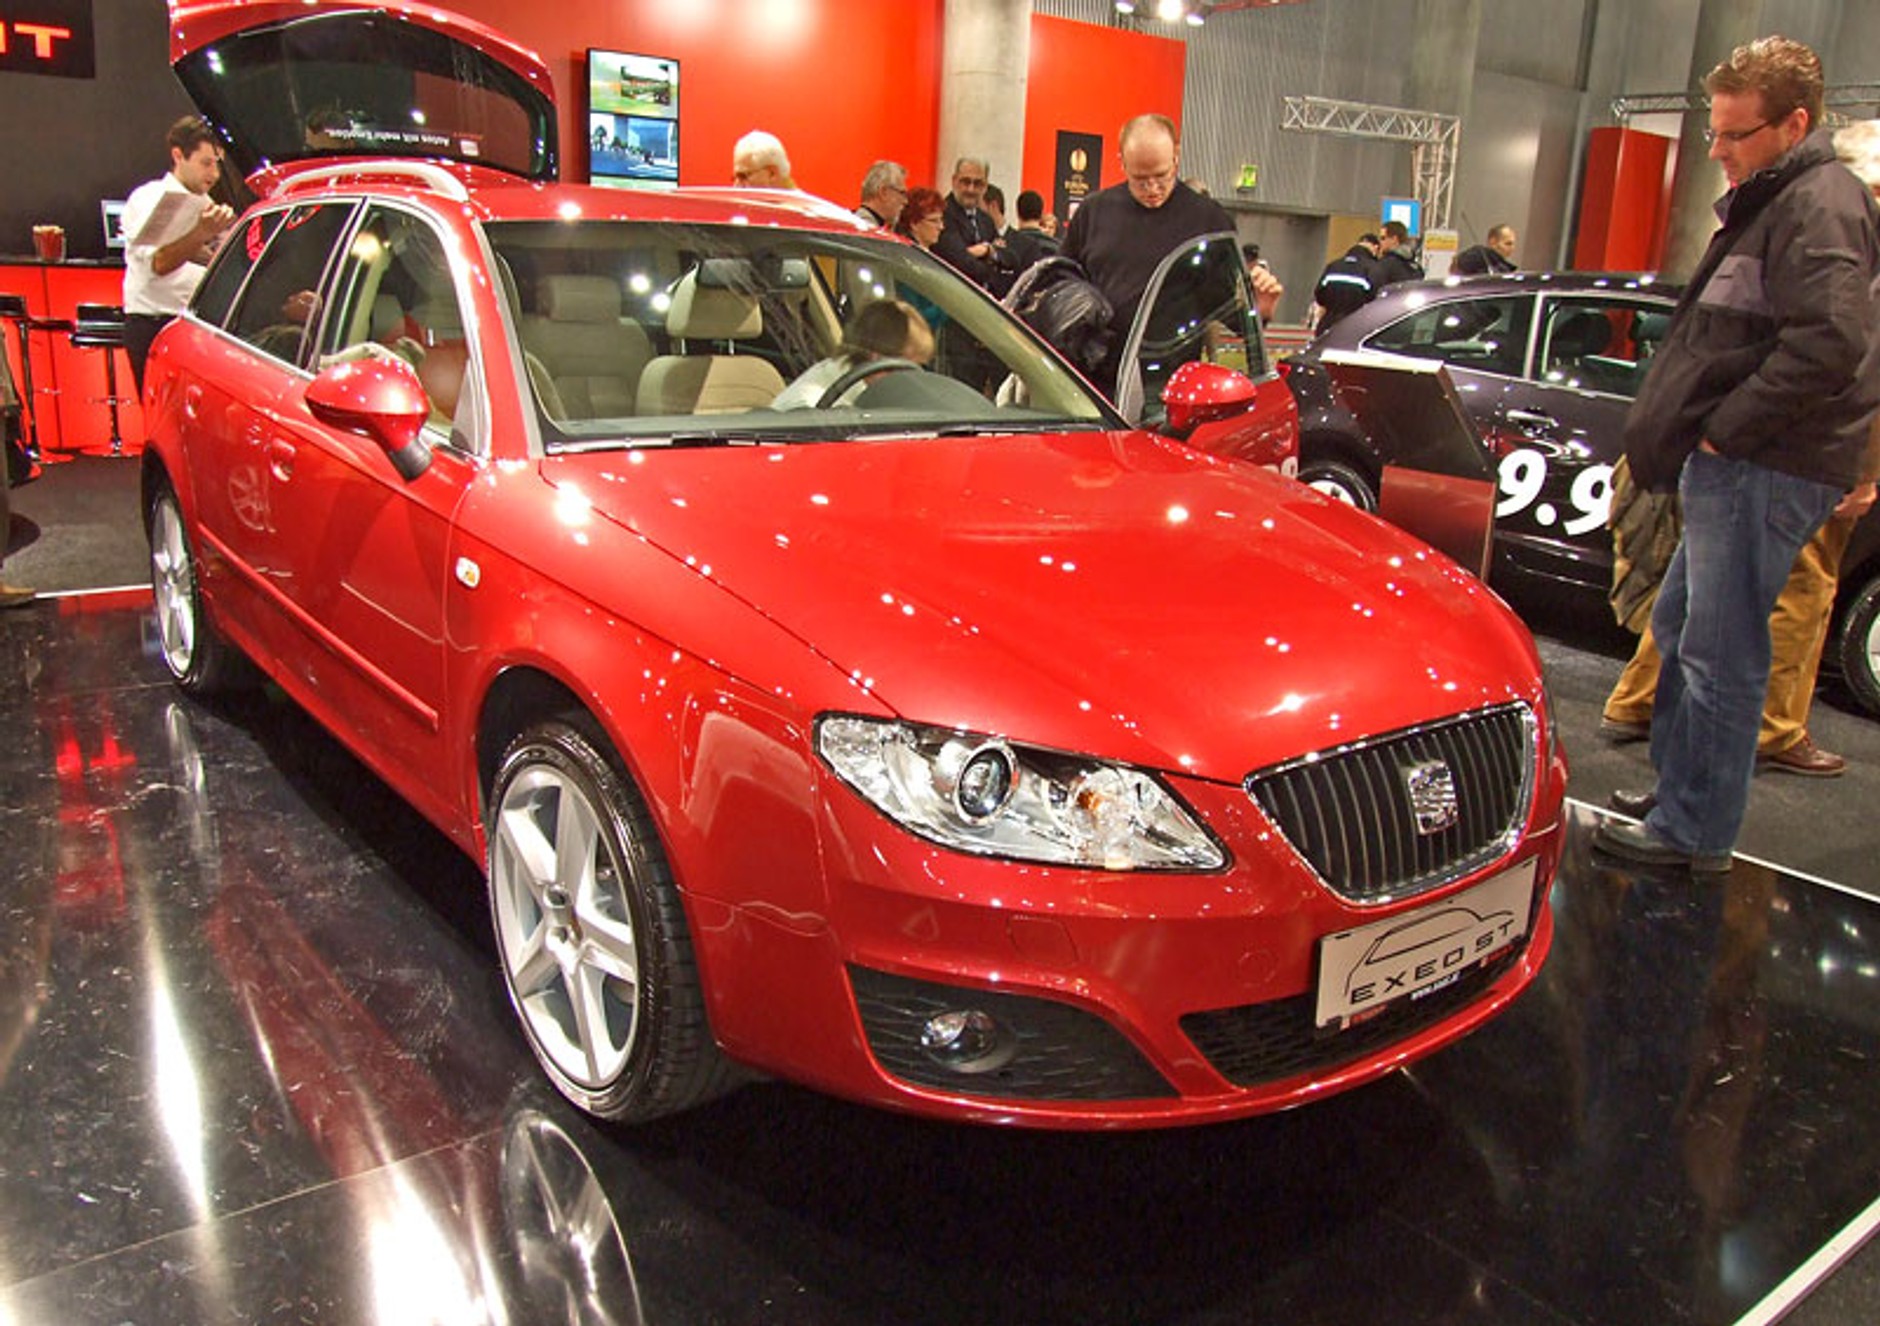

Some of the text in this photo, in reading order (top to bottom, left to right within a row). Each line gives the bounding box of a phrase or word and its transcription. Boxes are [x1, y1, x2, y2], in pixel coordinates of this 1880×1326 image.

[0, 21, 71, 58] T
[1350, 946, 1465, 1005] EXEO
[1474, 918, 1515, 953] ST
